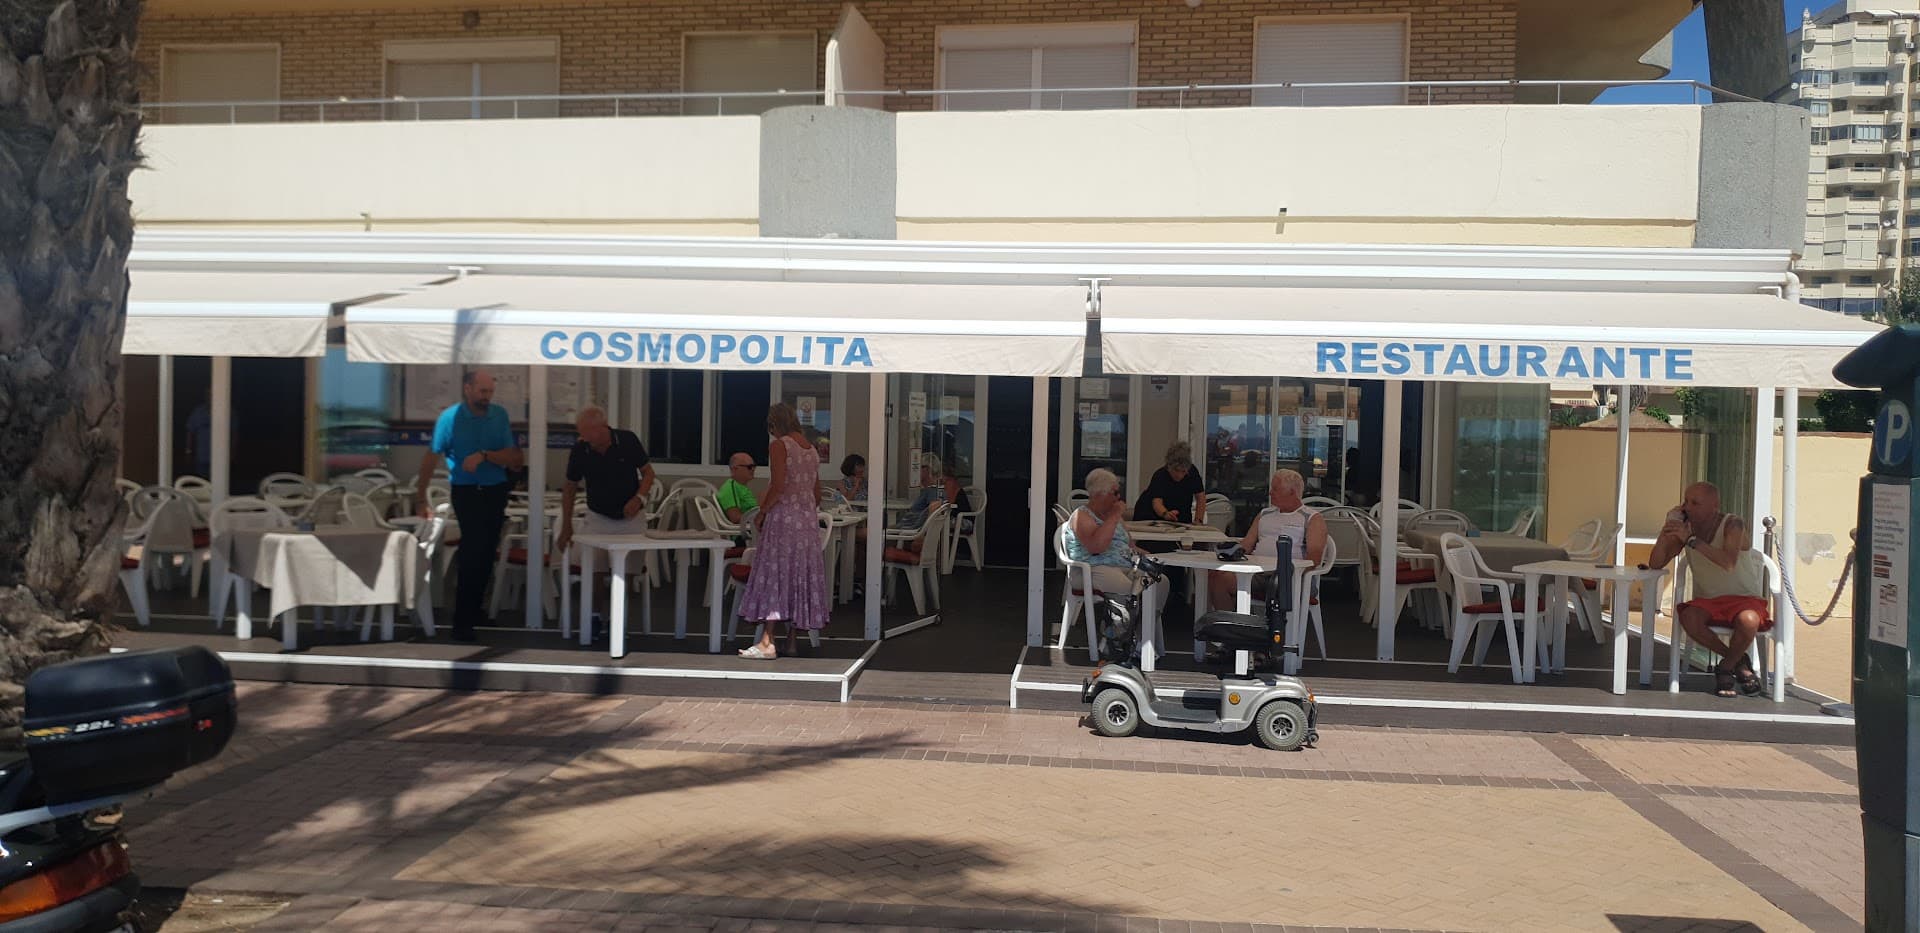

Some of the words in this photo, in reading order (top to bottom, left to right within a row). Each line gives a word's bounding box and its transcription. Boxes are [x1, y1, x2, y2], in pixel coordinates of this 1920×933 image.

[540, 331, 874, 367] COSMOPOLITA
[1316, 341, 1694, 380] RESTAURANTE
[1884, 400, 1911, 463] P
